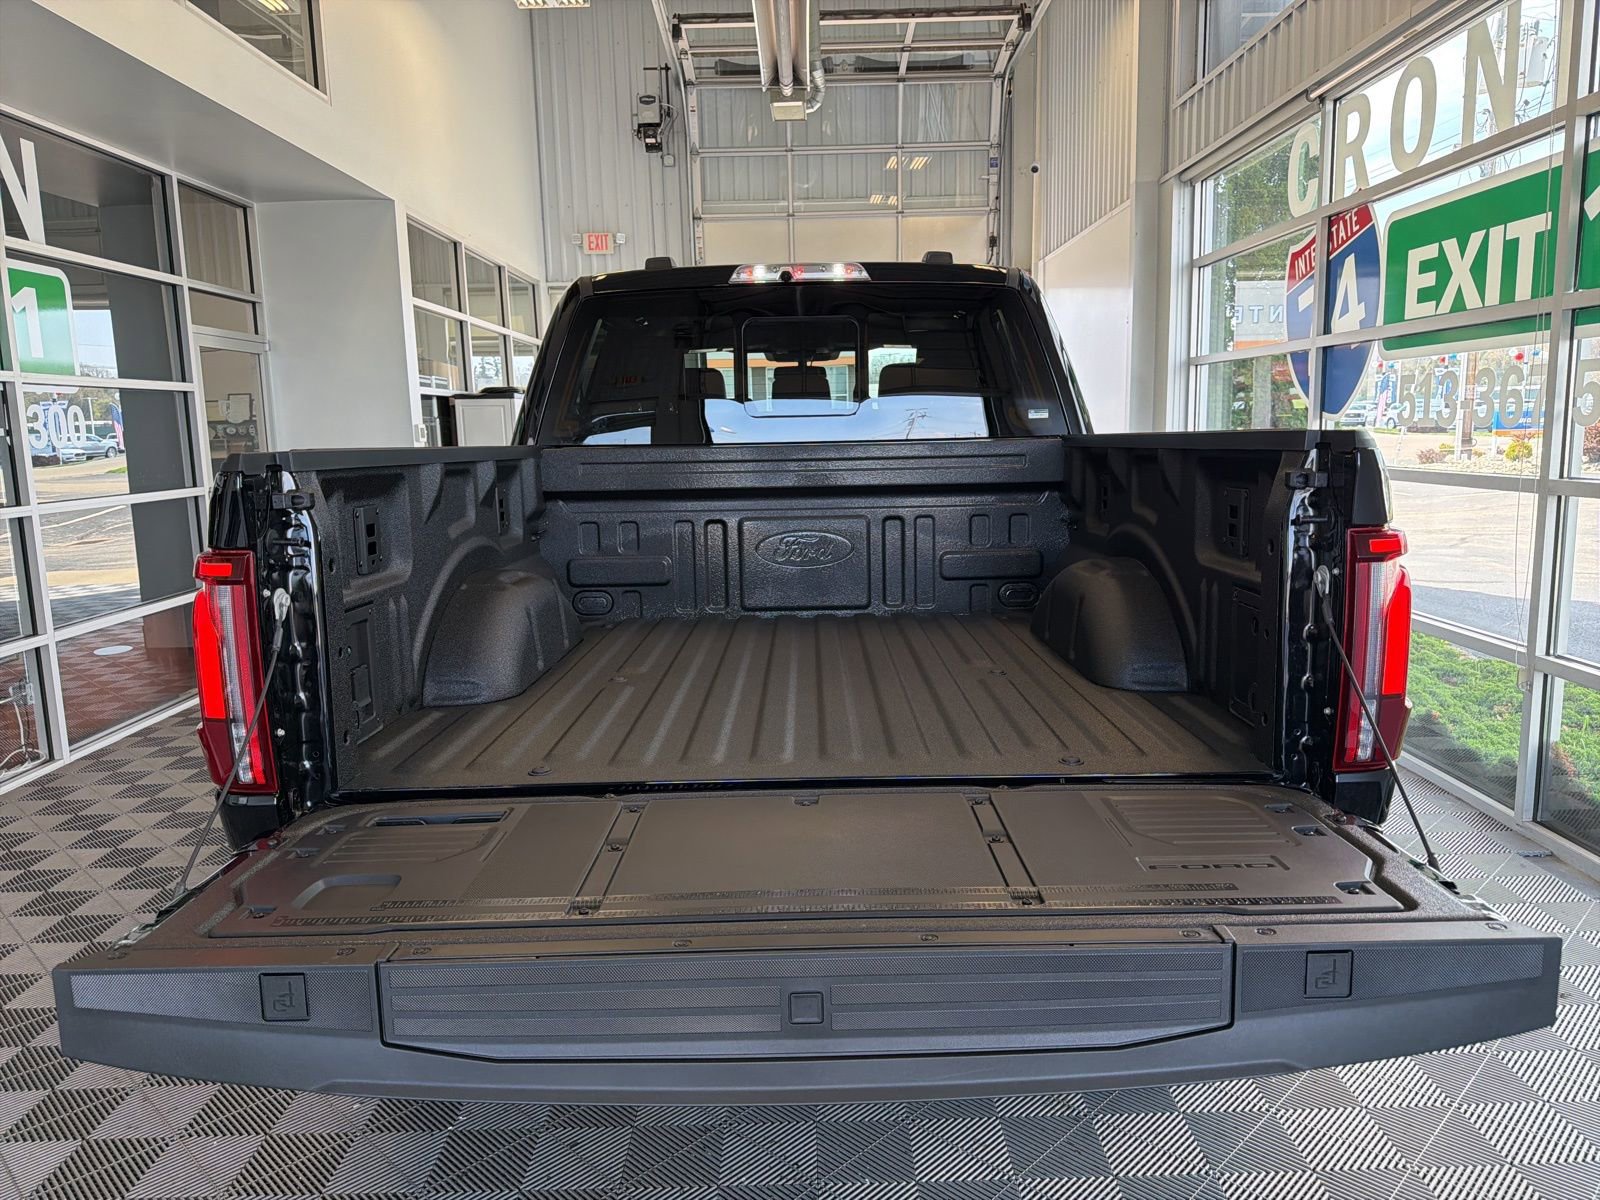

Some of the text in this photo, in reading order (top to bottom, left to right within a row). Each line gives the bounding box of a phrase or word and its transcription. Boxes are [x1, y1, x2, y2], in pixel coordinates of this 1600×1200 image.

[1288, 0, 1522, 218] CRON
[588, 234, 608, 250] EXIT
[1295, 208, 1361, 281] INTETATE
[1405, 211, 1553, 320] EXIT
[774, 534, 837, 562] Ford
[1148, 862, 1277, 870] FORD
